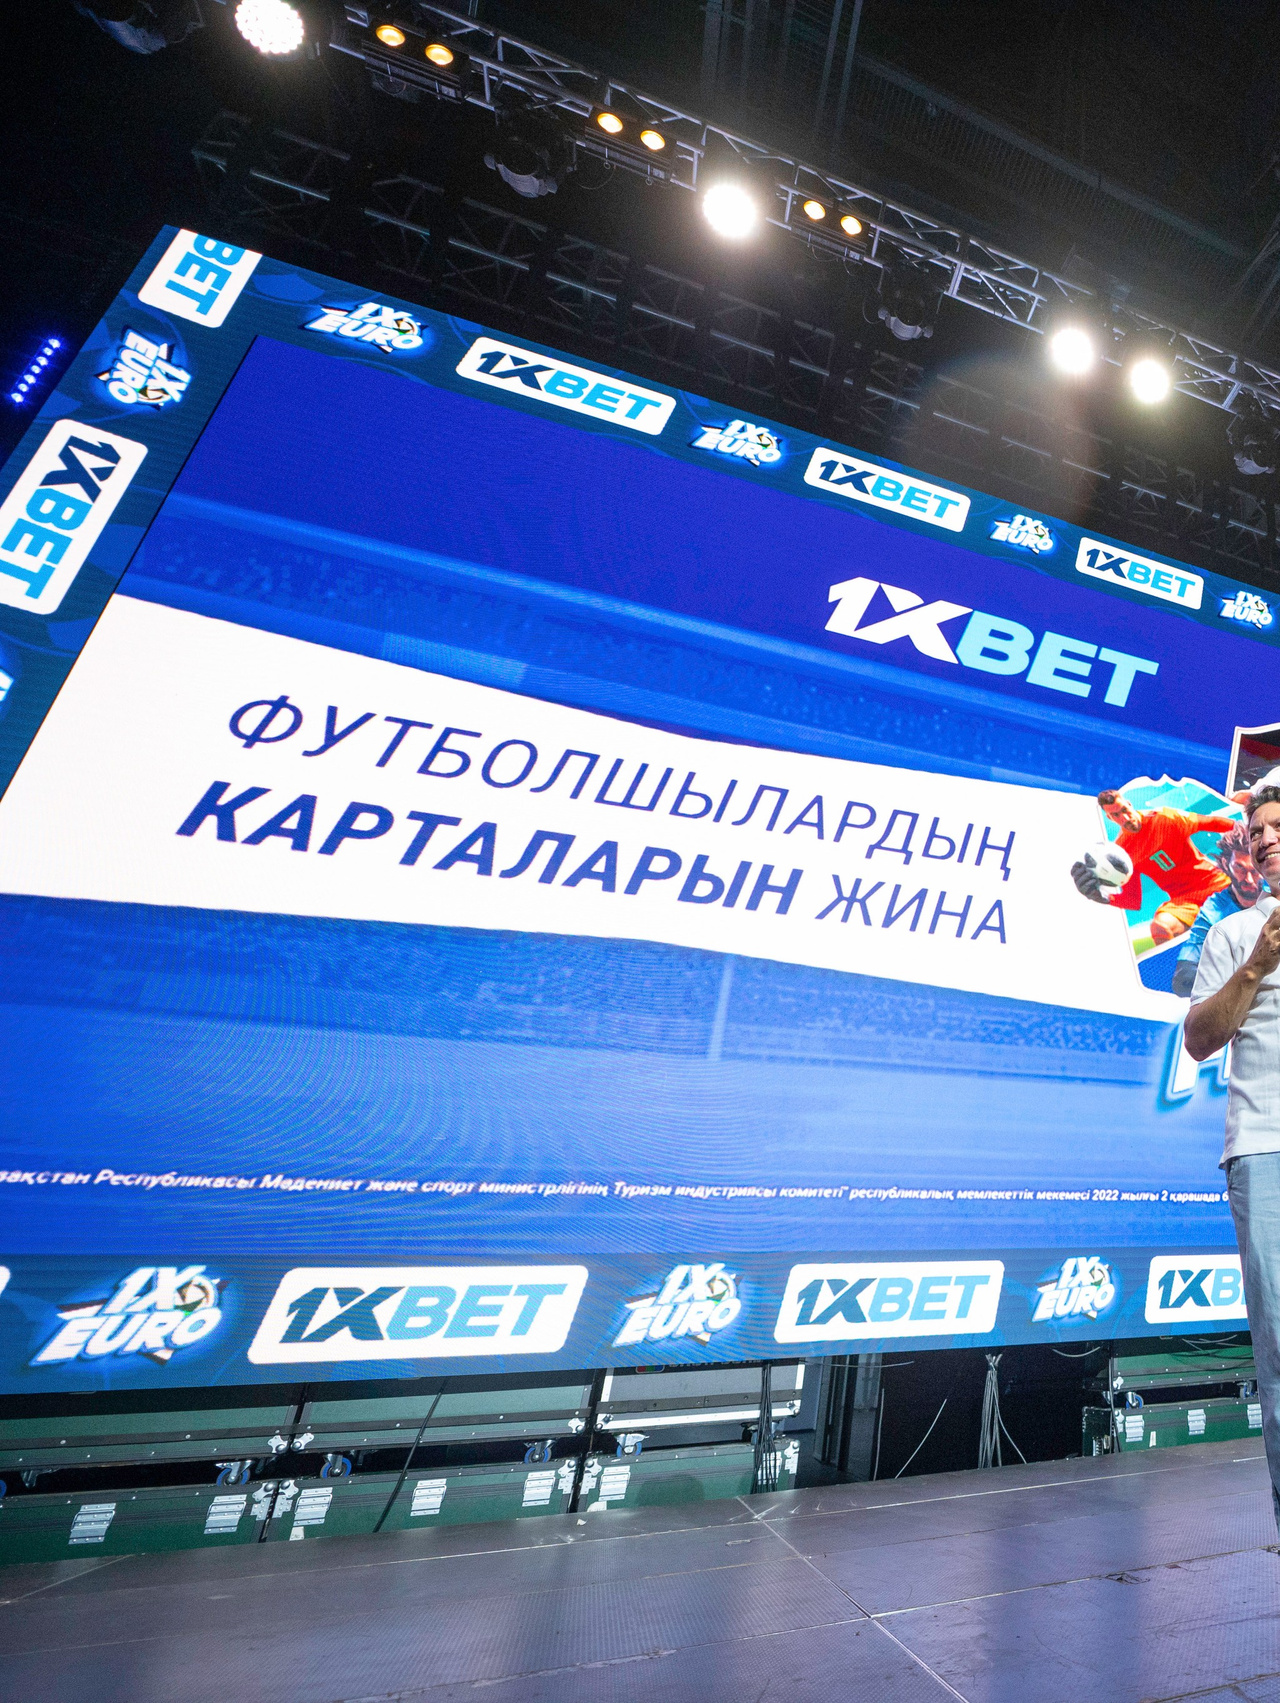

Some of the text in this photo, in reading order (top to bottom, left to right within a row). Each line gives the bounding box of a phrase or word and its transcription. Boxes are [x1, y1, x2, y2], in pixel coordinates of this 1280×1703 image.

[304, 314, 424, 349] EURO
[107, 330, 160, 404] EURO
[476, 350, 662, 422] 1XBET
[691, 432, 781, 463] EURO
[819, 460, 960, 520] 1XBET
[0, 435, 122, 600] 1XBET
[990, 526, 1053, 551] EURO
[1086, 548, 1196, 599] 1XBET
[1220, 603, 1272, 625] EURO
[825, 577, 1159, 708] 1XBET
[229, 695, 1016, 881] ФУТБОЛШЫЛАРДЫҢ
[176, 781, 1007, 943] КАРТАЛАРЫН ЖИНА
[1150, 850, 1176, 871] 10
[1092, 1189, 1119, 1201] 2022
[1161, 1190, 1168, 1201] 2
[278, 1283, 568, 1344] 1XBET
[611, 1298, 741, 1347] EURO
[795, 1275, 991, 1326] 1XBET
[1032, 1283, 1115, 1323] EURO
[29, 1307, 222, 1366] EURO
